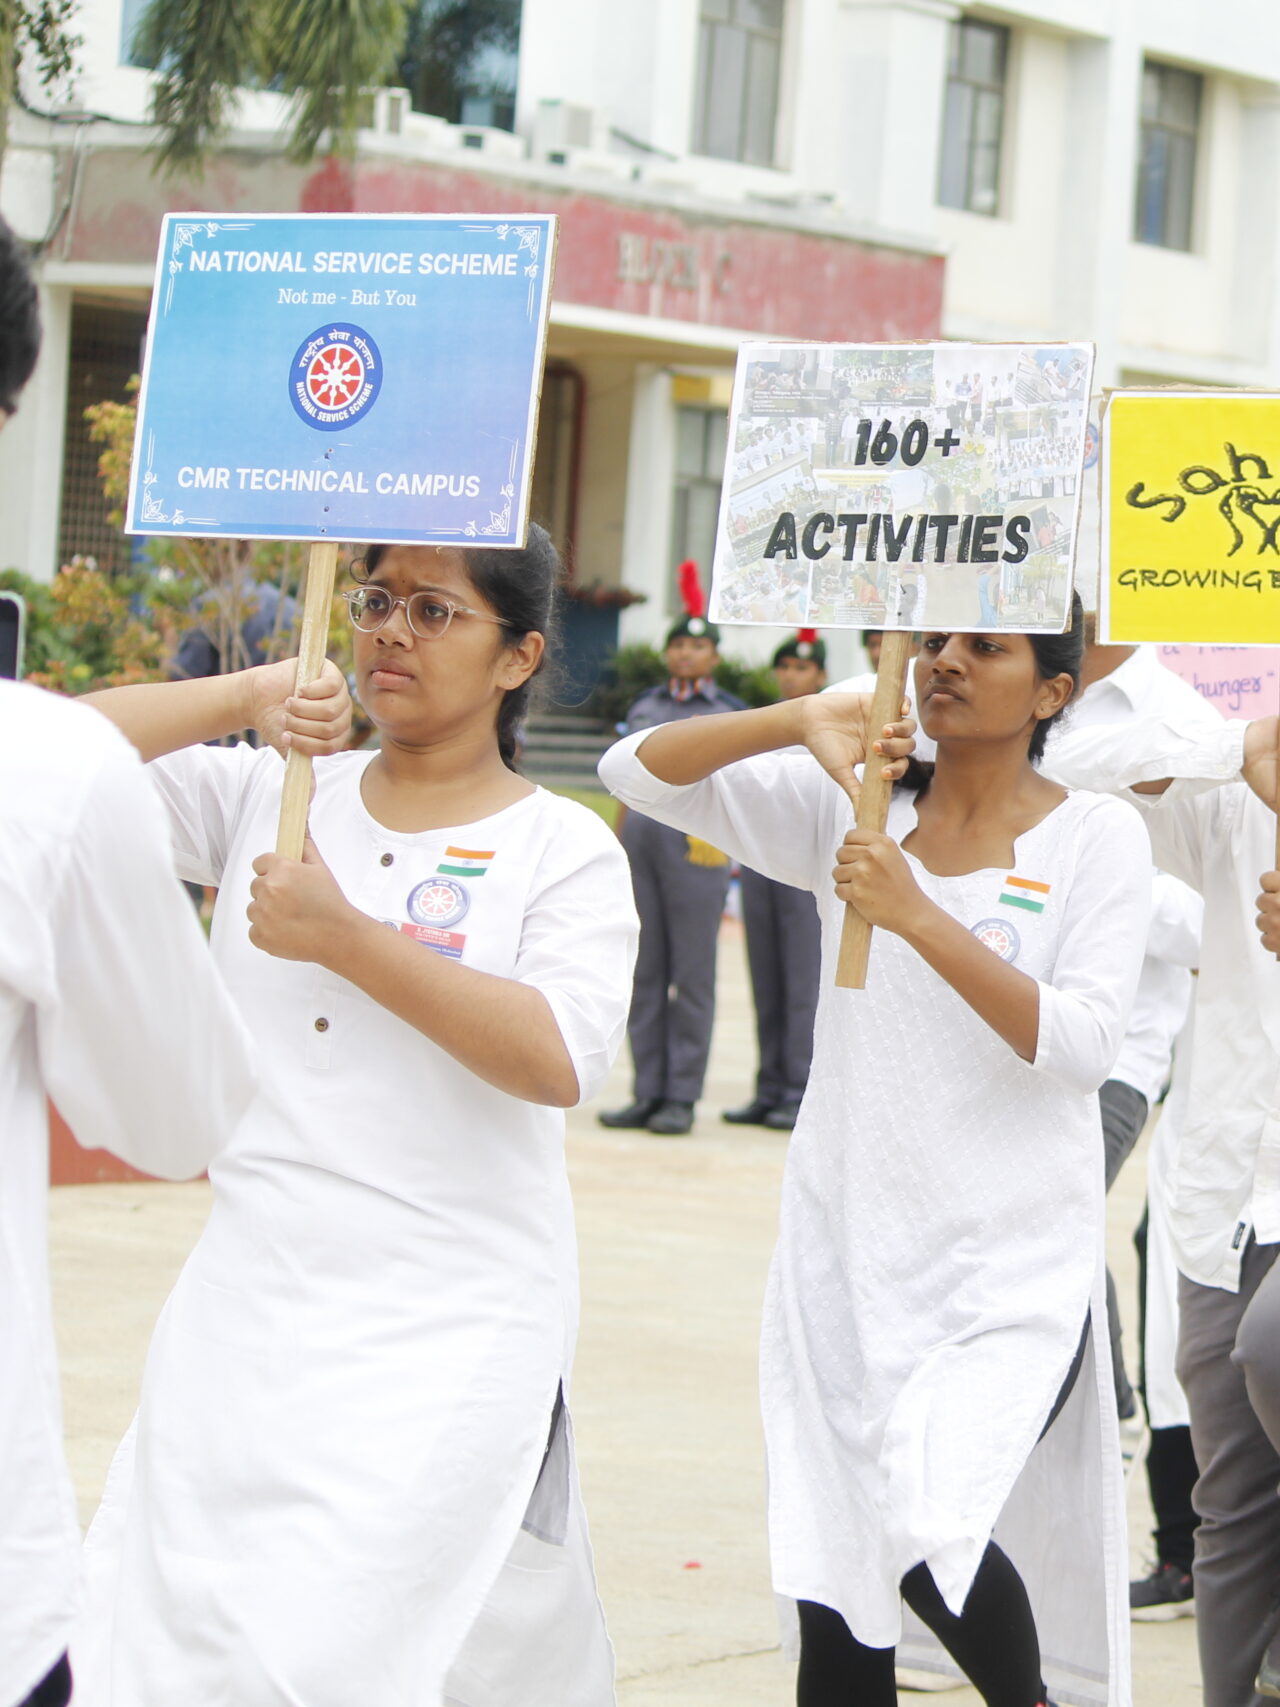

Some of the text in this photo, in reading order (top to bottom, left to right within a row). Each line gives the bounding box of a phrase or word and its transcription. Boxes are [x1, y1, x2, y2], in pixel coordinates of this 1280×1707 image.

[189, 251, 518, 276] NATIONAL SERVICE SCHEME
[278, 288, 307, 305] Not
[312, 293, 336, 305] me
[351, 289, 380, 306] But
[385, 290, 416, 307] You
[328, 328, 351, 341] सेवा
[354, 336, 375, 369] योजना
[296, 382, 374, 423] NATIONAL SERVICE SCHEME
[854, 418, 961, 466] 160+
[177, 466, 481, 497] CMR TECHNICAL CAMPUS
[763, 512, 1031, 563] ACTIVITIES
[1117, 569, 1262, 593] GROWING
